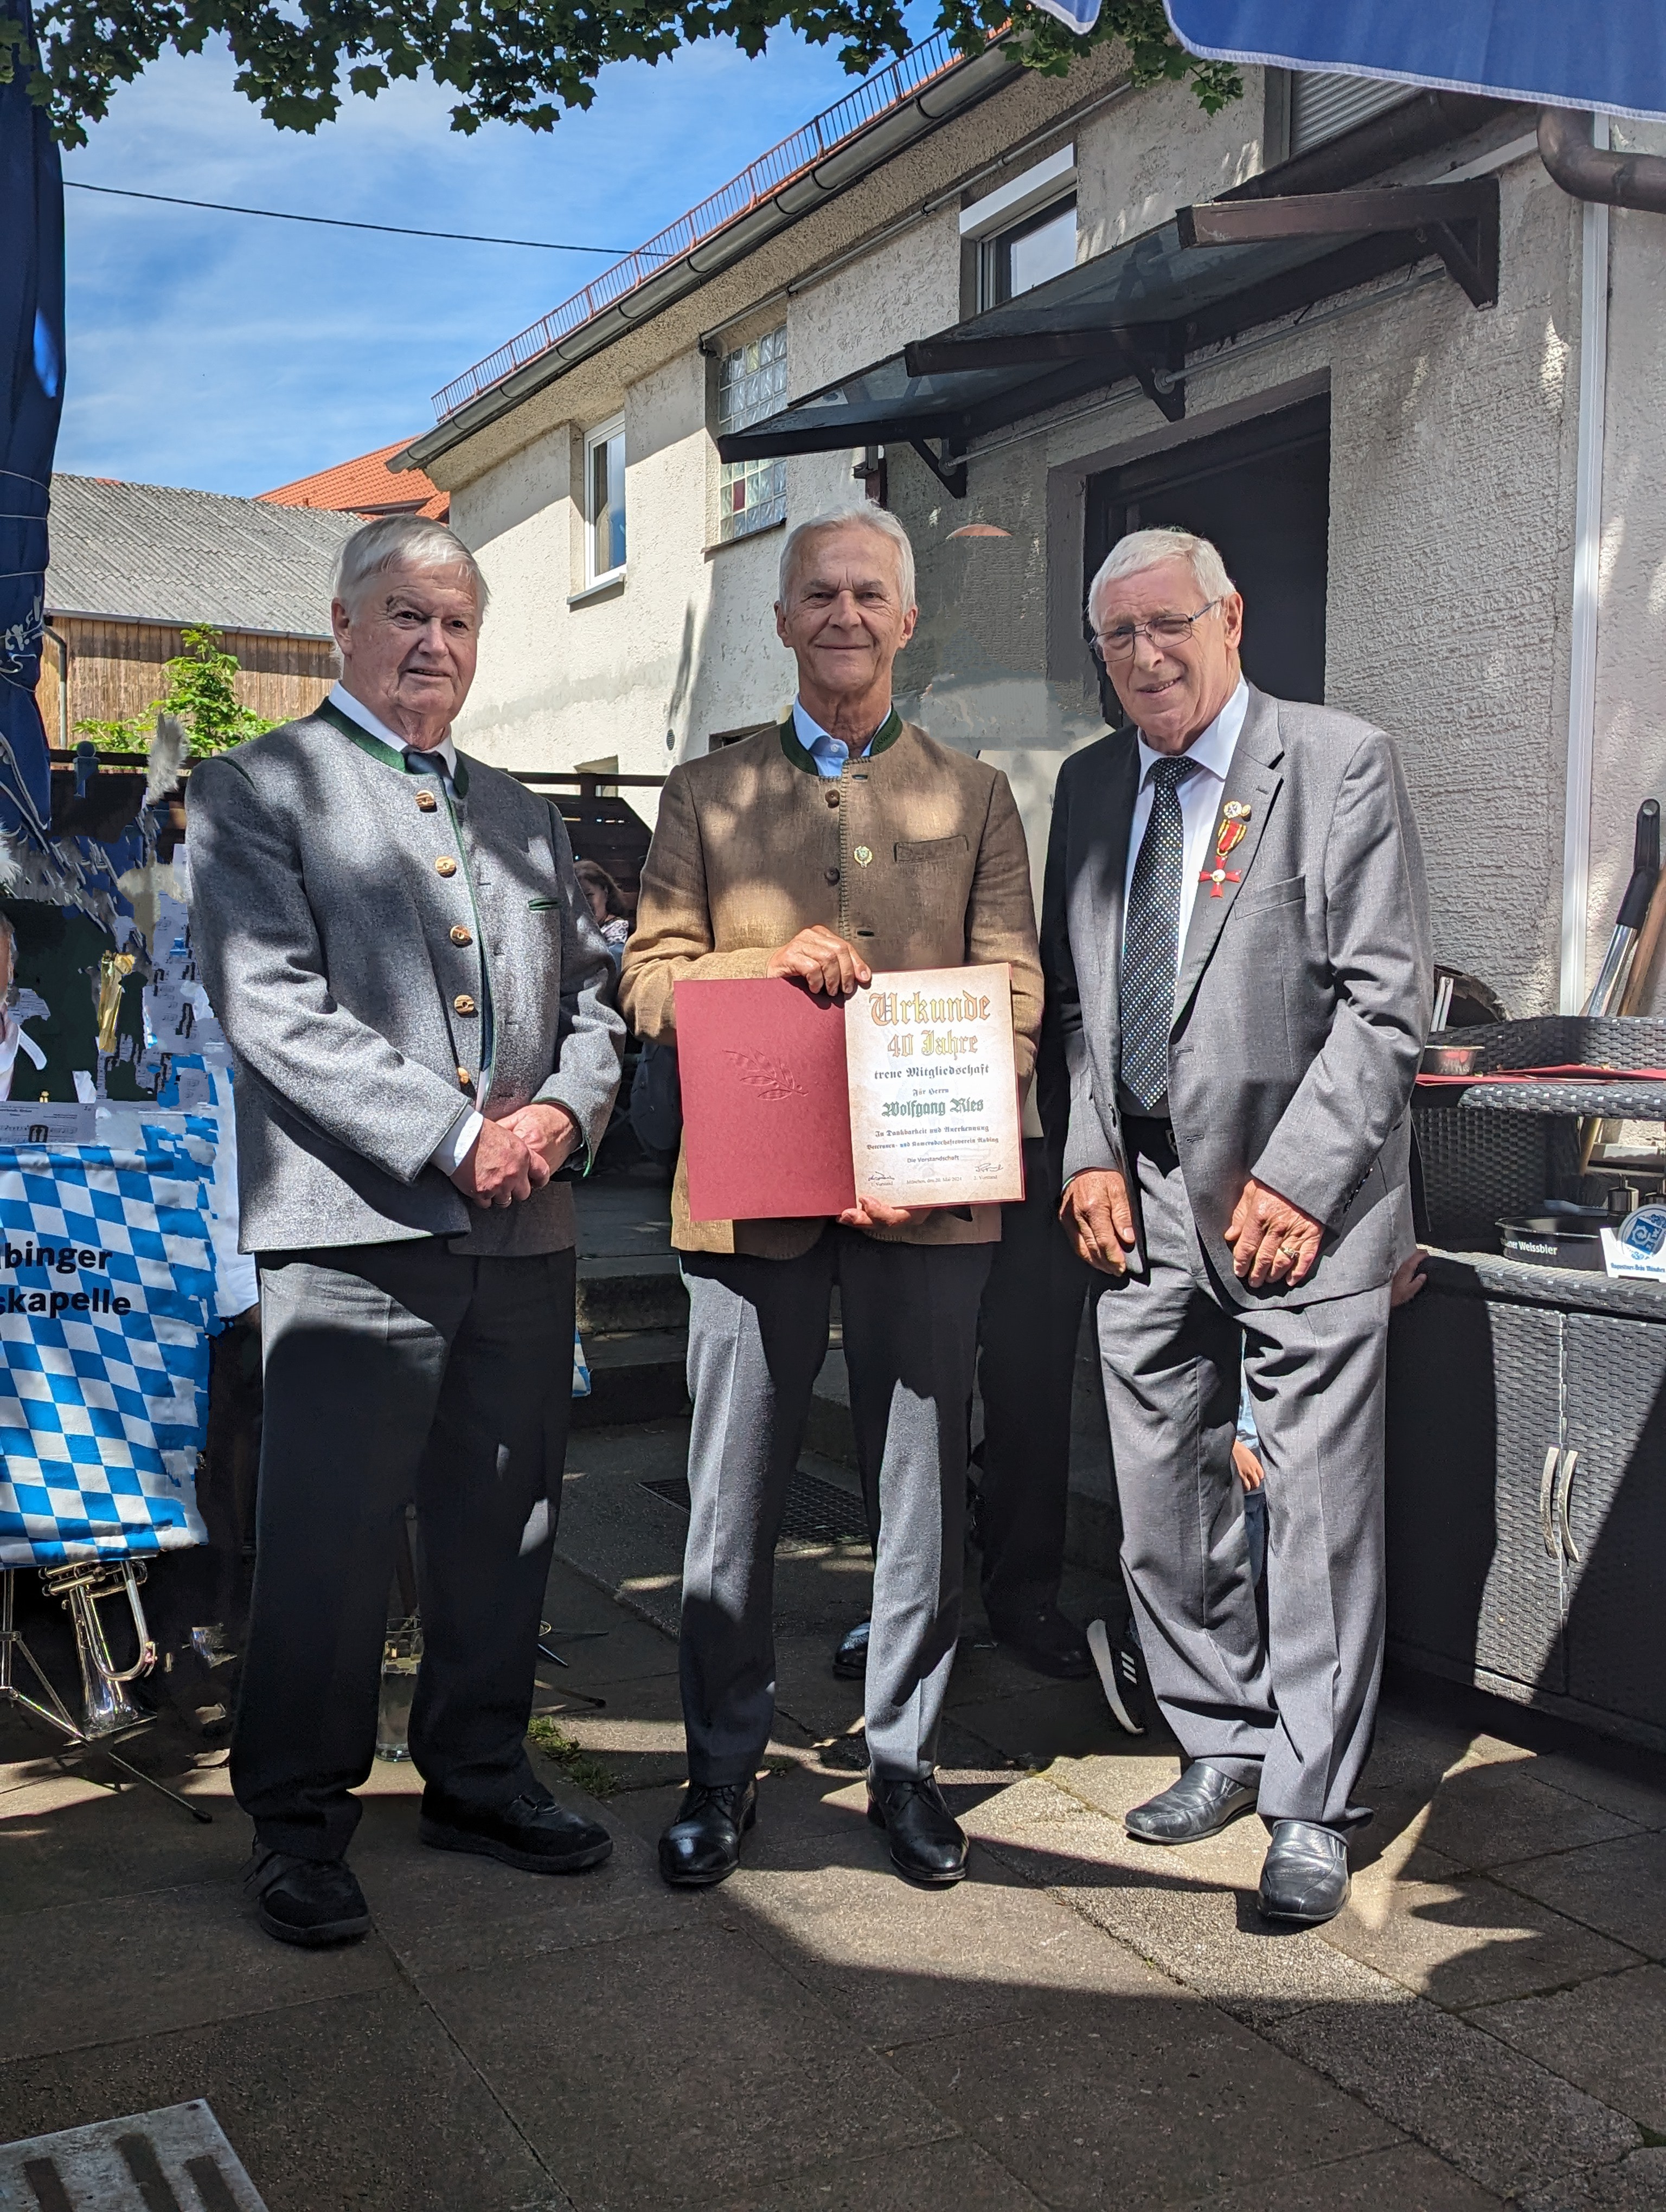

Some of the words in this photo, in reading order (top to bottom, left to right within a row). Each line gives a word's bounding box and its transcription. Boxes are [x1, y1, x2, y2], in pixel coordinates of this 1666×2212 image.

[869, 990, 991, 1026] Urkunde
[887, 1033, 914, 1058] 40
[921, 1030, 978, 1060] Jahre
[874, 1070, 902, 1079] treue
[906, 1064, 989, 1079] Mitgliedschaft
[882, 1100, 946, 1118] Wolfgang
[950, 1097, 984, 1114] Ries
[886, 1128, 927, 1136] Dankbarkeit
[0, 1240, 113, 1274] binger
[1518, 1240, 1559, 1256] Weissbier
